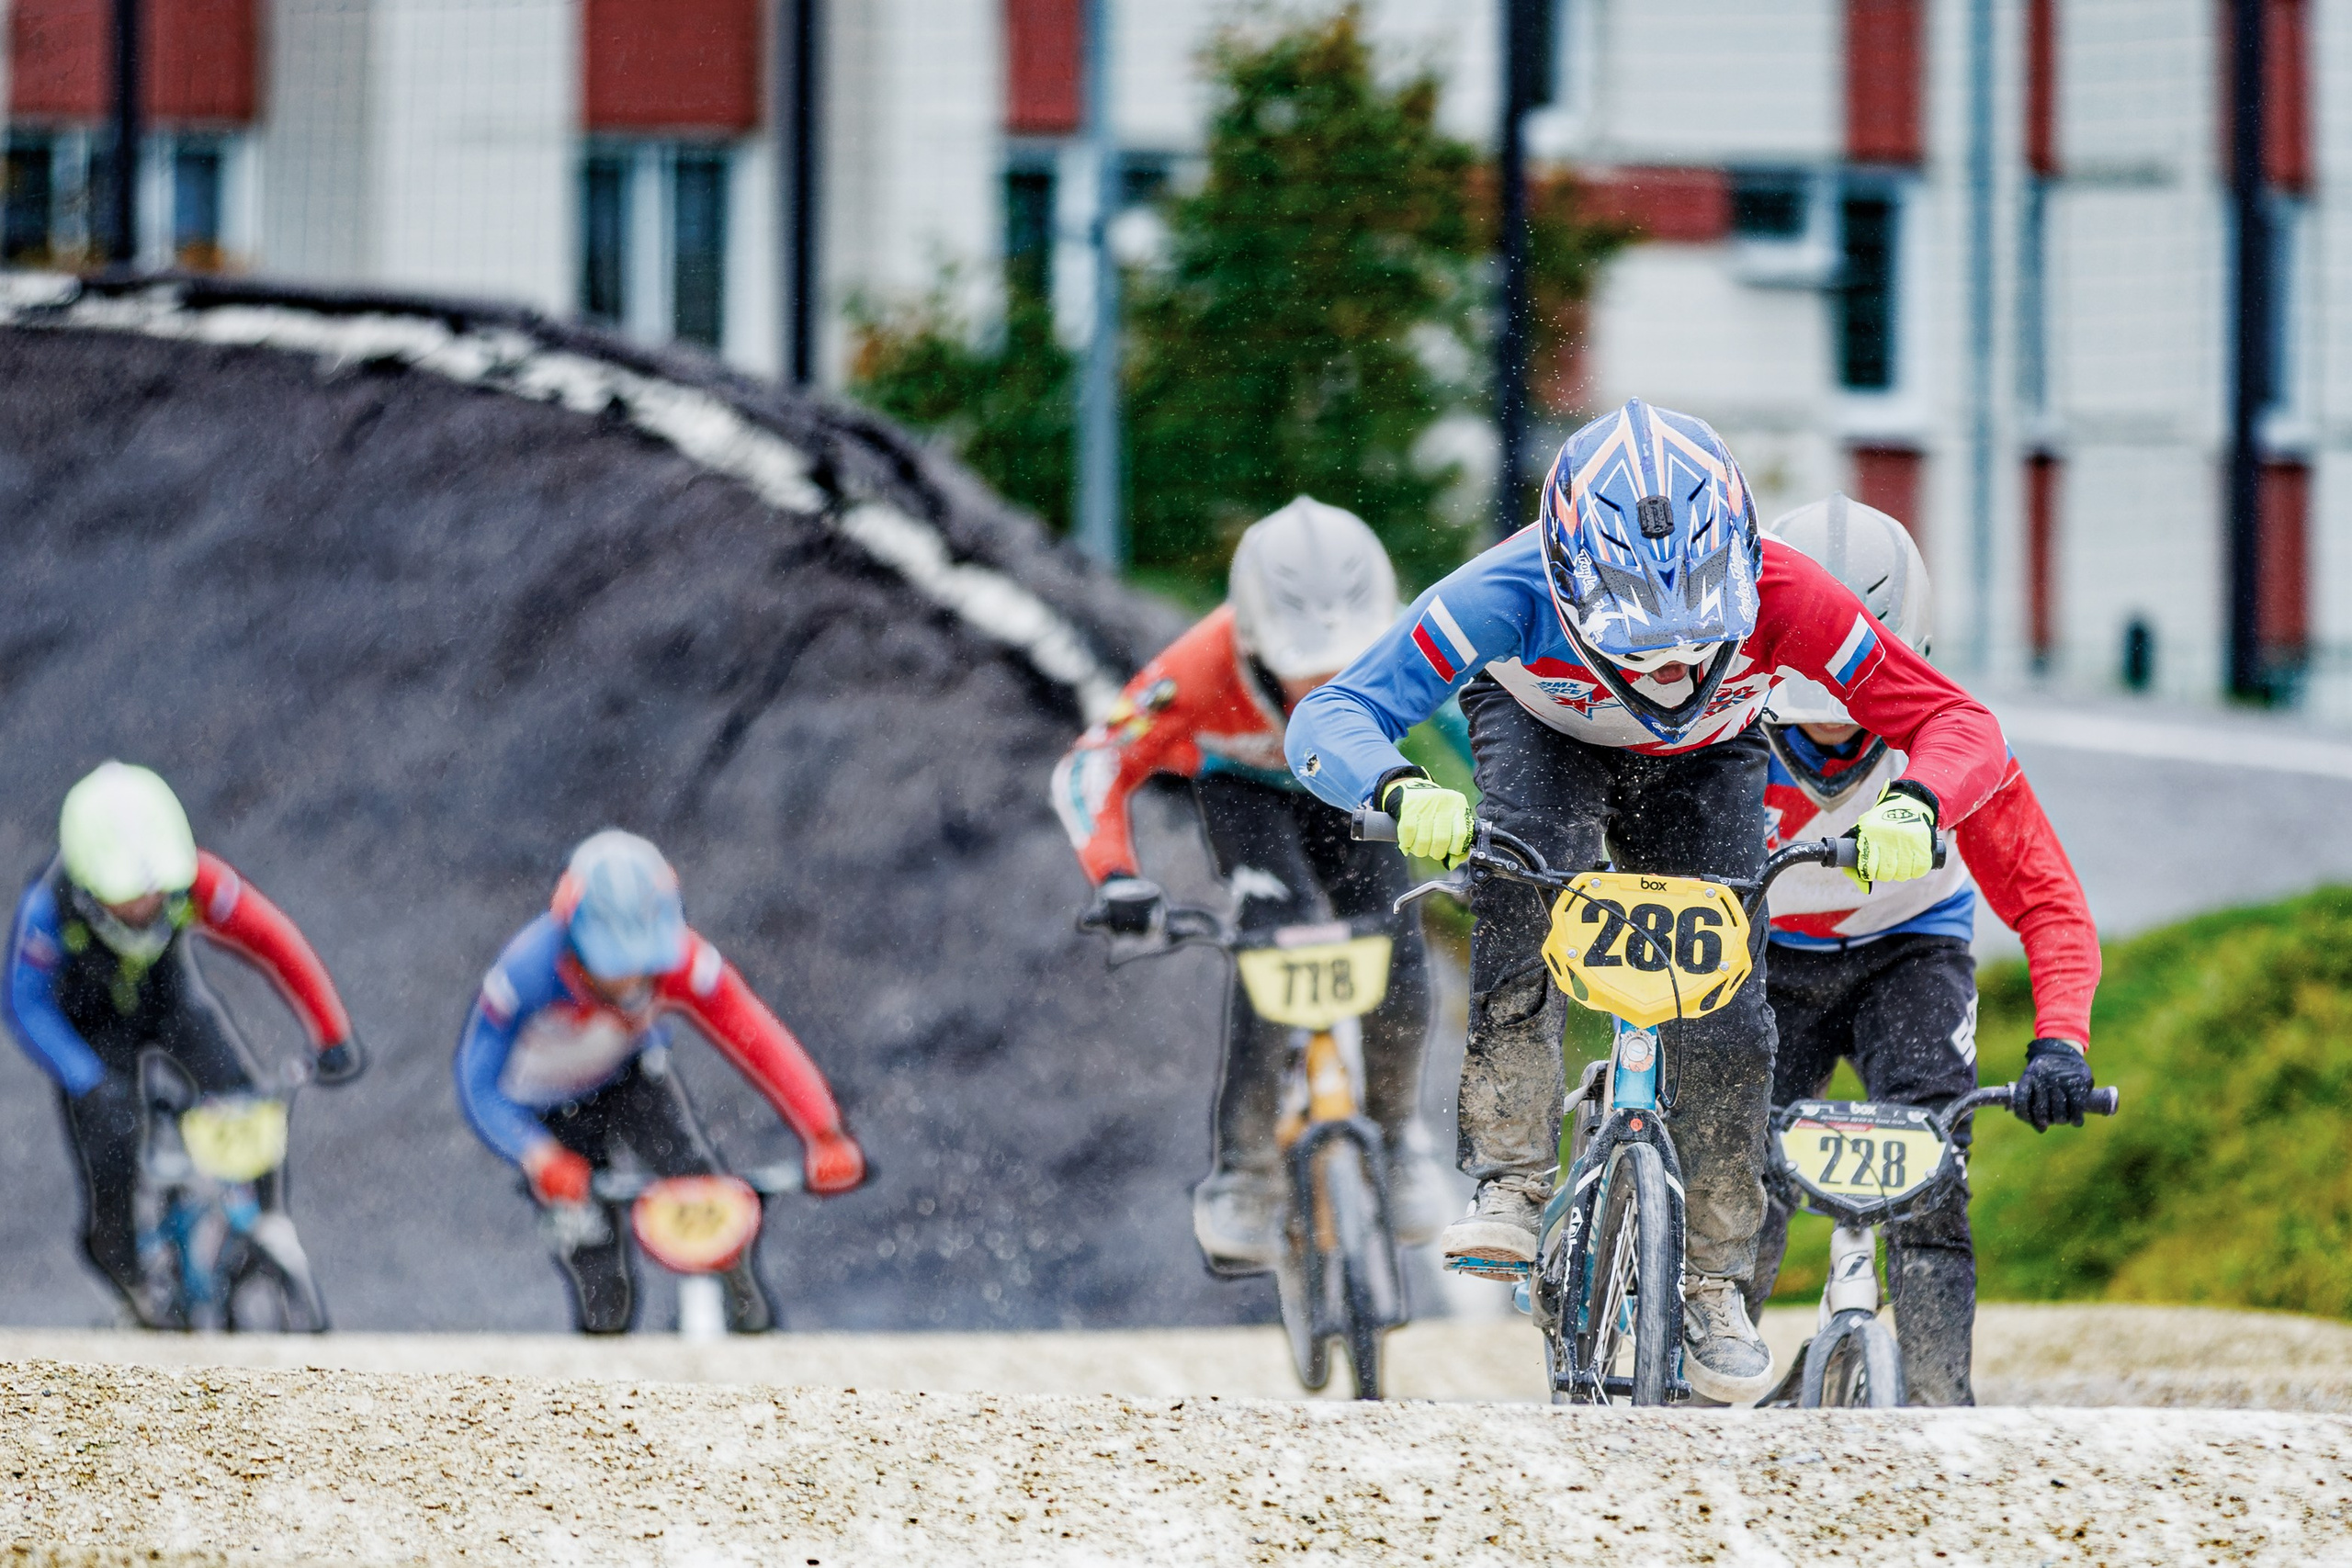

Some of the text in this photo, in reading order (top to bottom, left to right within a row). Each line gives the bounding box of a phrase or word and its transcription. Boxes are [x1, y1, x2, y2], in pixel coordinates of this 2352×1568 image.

[1574, 548, 1592, 578] Troy
[1641, 877, 1667, 891] box
[1580, 898, 1724, 976] 286
[1849, 1101, 1877, 1115] box
[1818, 1135, 1906, 1188] 228
